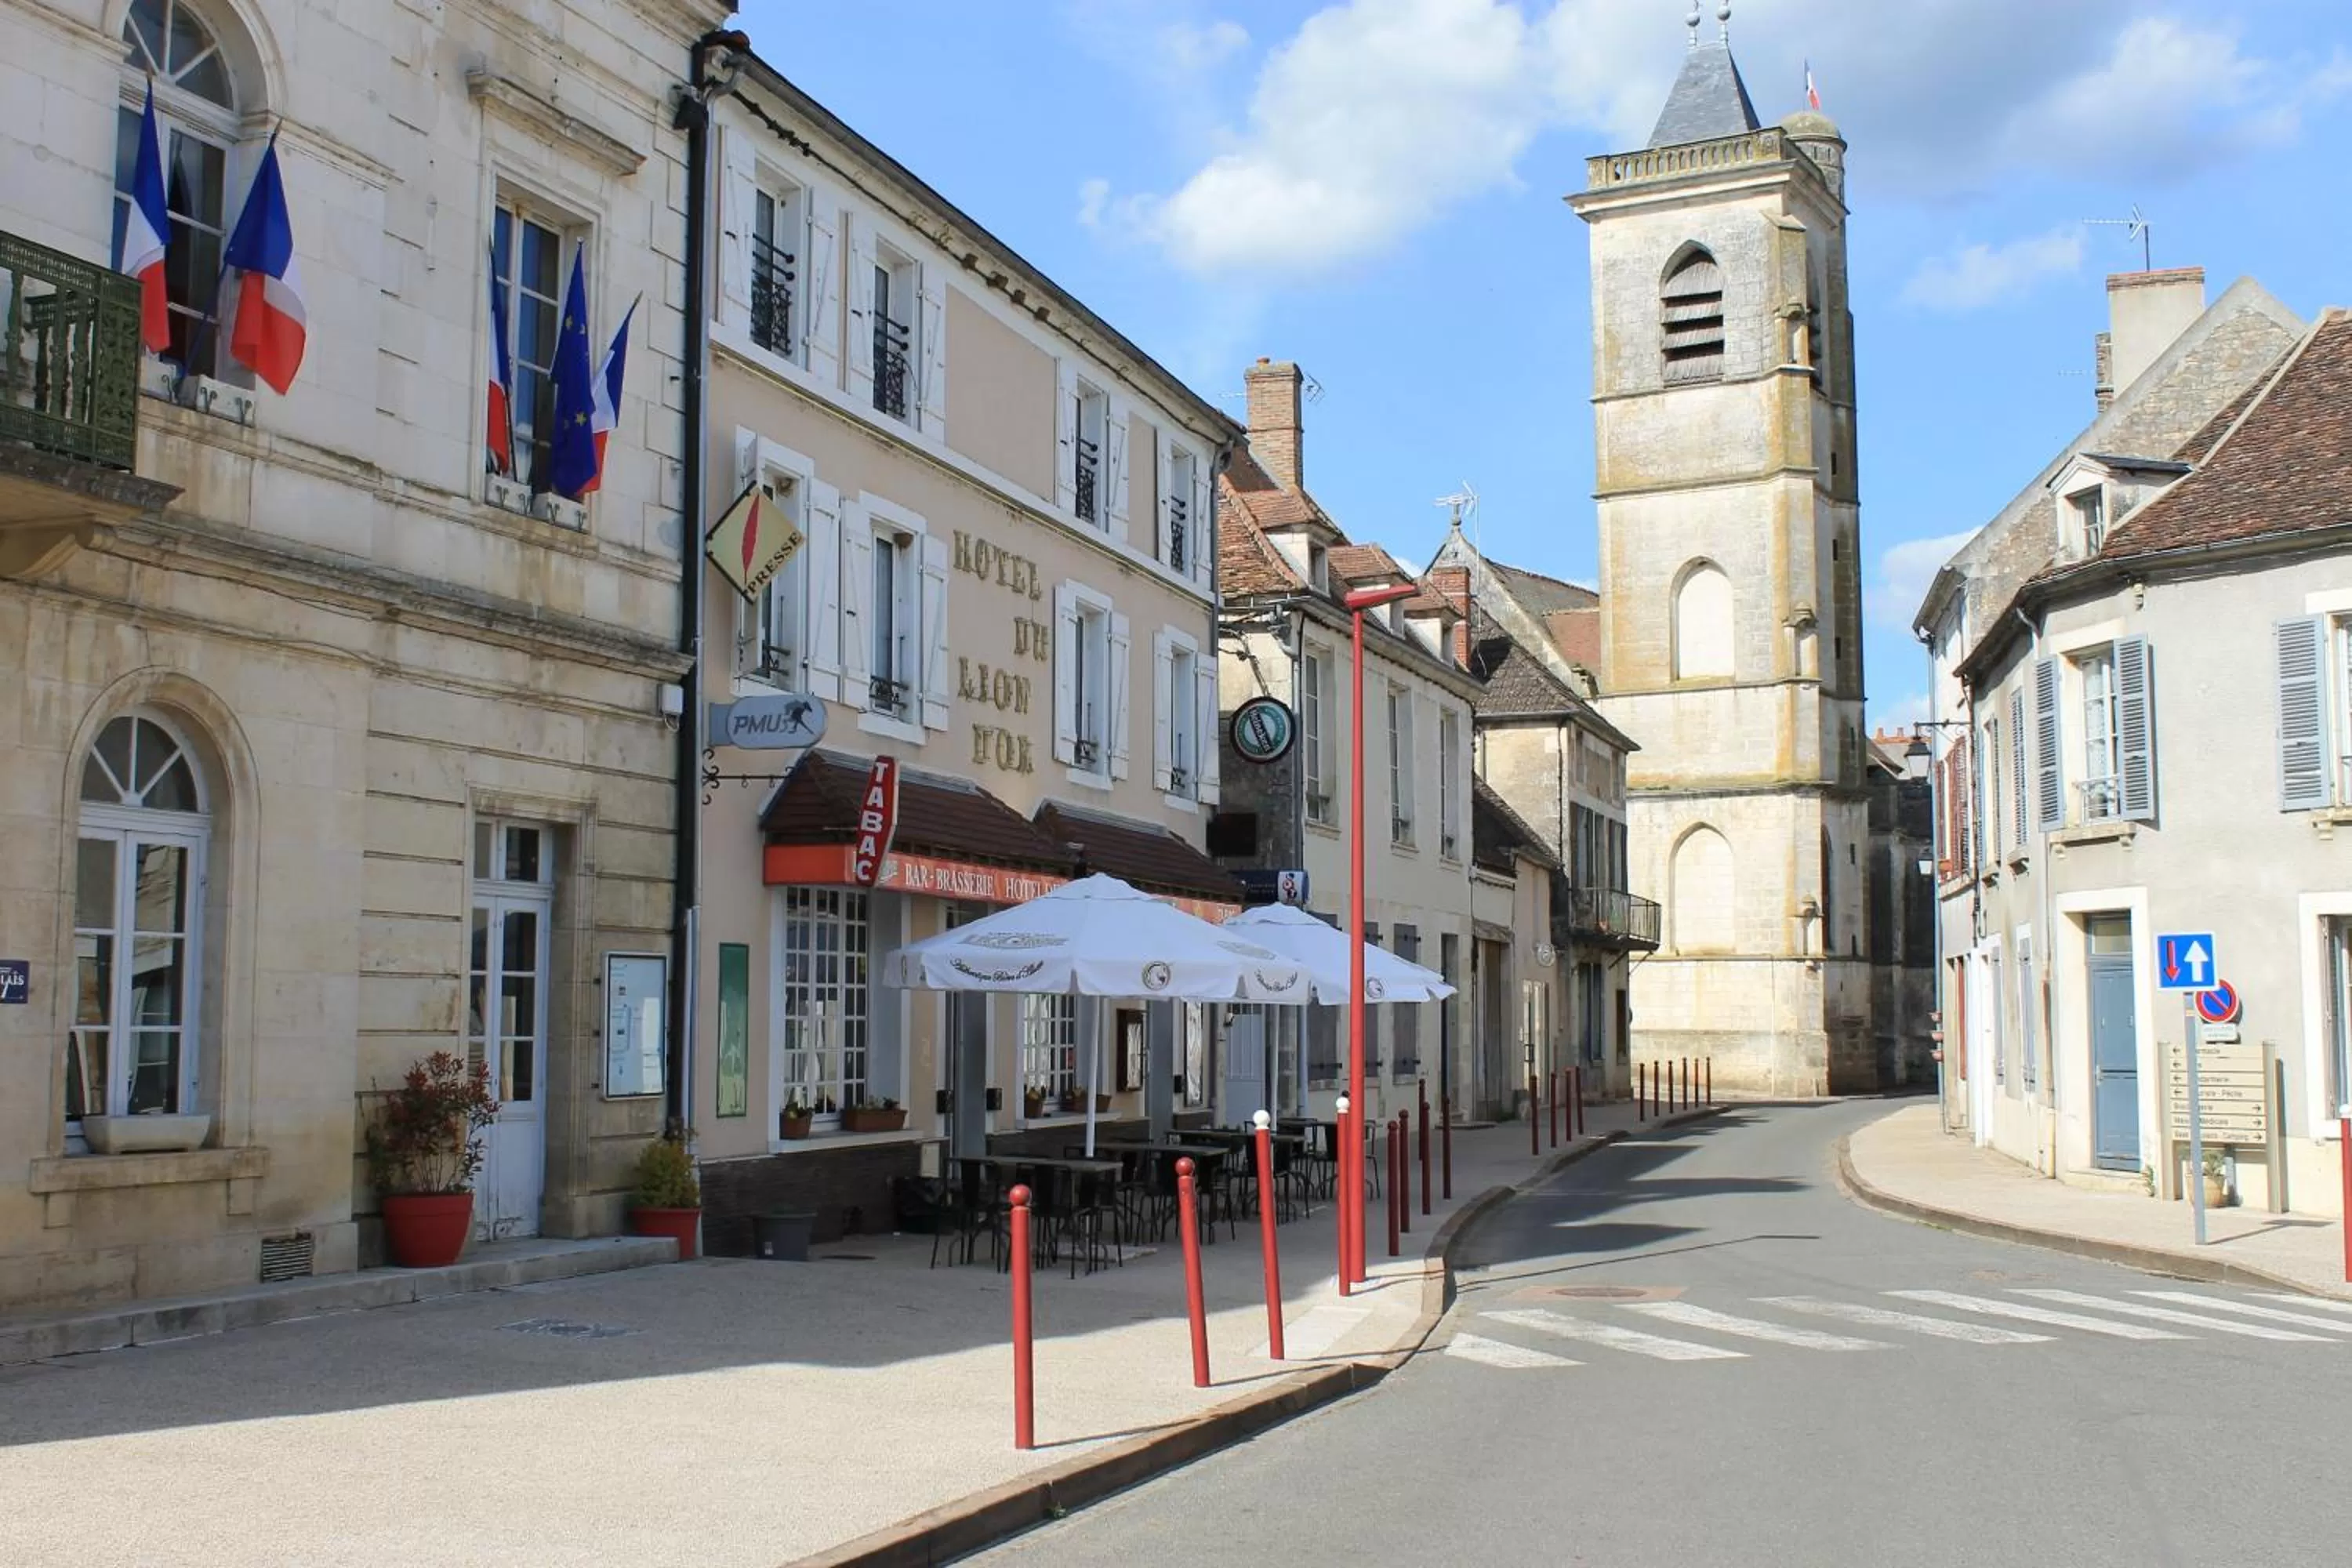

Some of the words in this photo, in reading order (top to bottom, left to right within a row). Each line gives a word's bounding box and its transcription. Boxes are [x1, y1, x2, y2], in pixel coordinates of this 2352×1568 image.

[746, 531, 804, 595] PRESSE
[953, 528, 1043, 601] HOTEL
[1013, 616, 1049, 662] DU
[956, 655, 1030, 715] LION
[732, 713, 784, 735] PMU
[856, 761, 889, 881] TABAC
